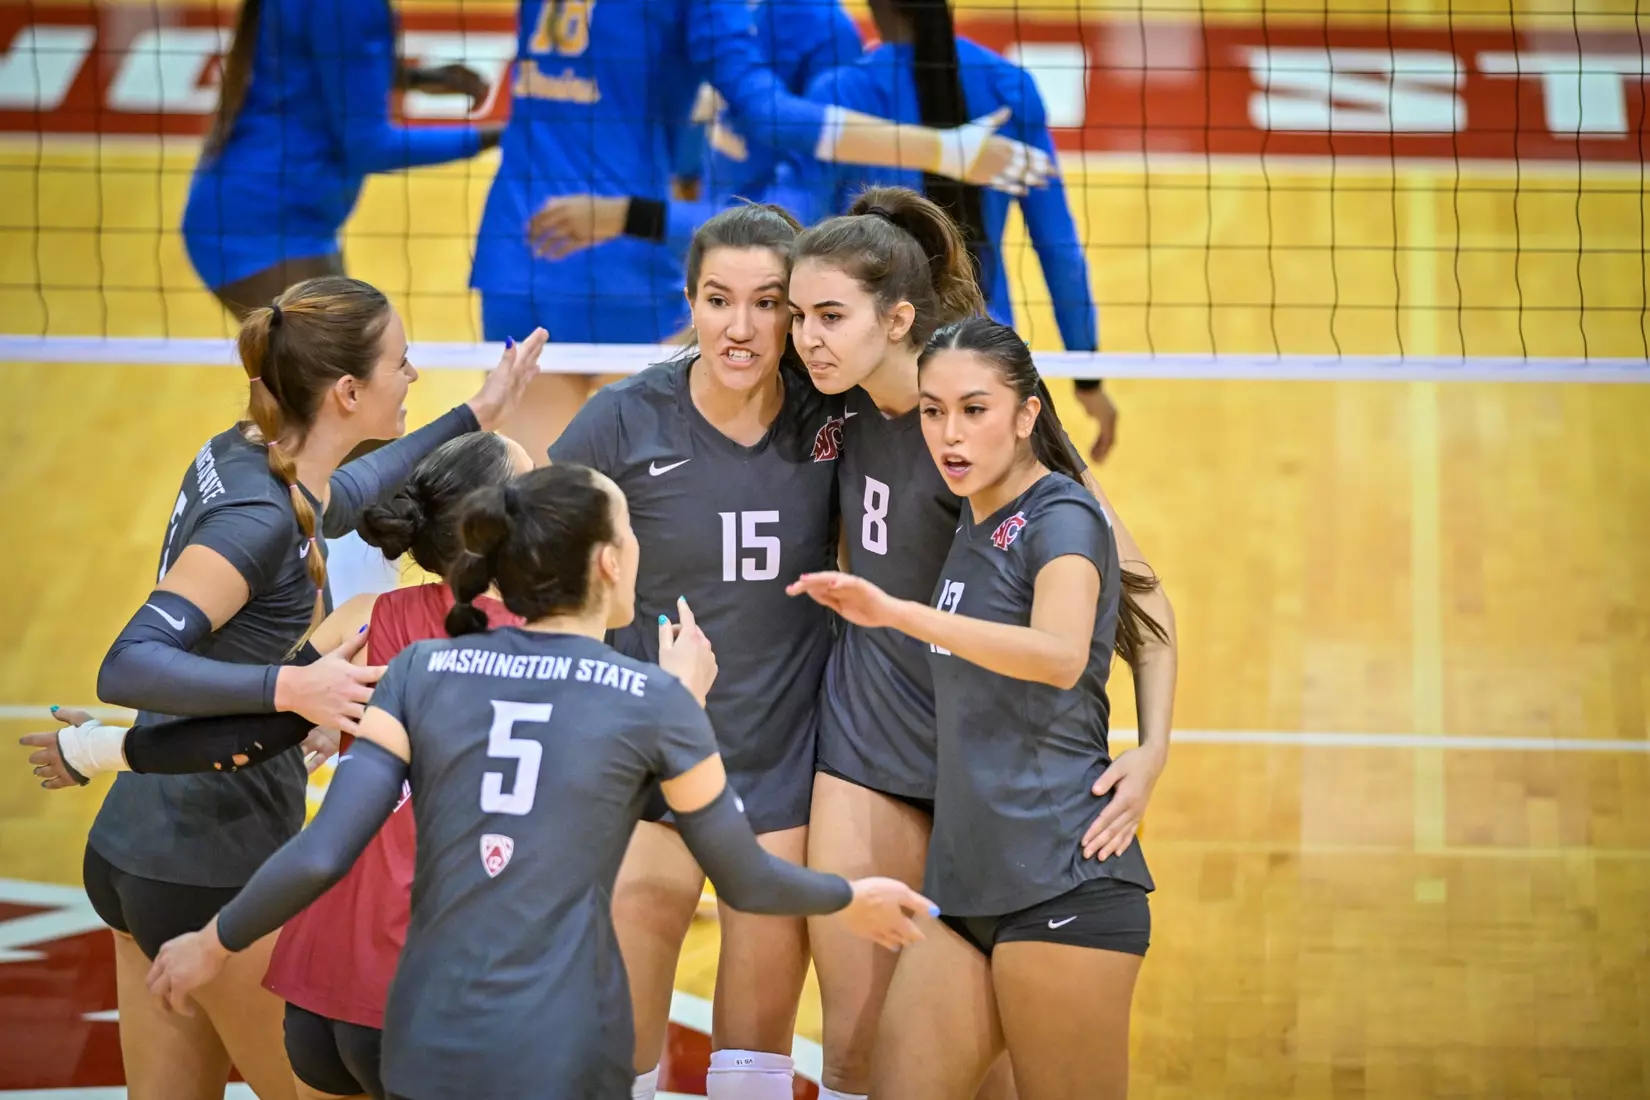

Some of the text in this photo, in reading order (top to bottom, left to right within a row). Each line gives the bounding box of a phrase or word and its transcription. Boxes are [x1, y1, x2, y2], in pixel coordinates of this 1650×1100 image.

[717, 510, 781, 582] 15
[861, 475, 890, 555] 8
[427, 648, 648, 697] WASHINGTON STATE
[480, 699, 553, 816] 5
